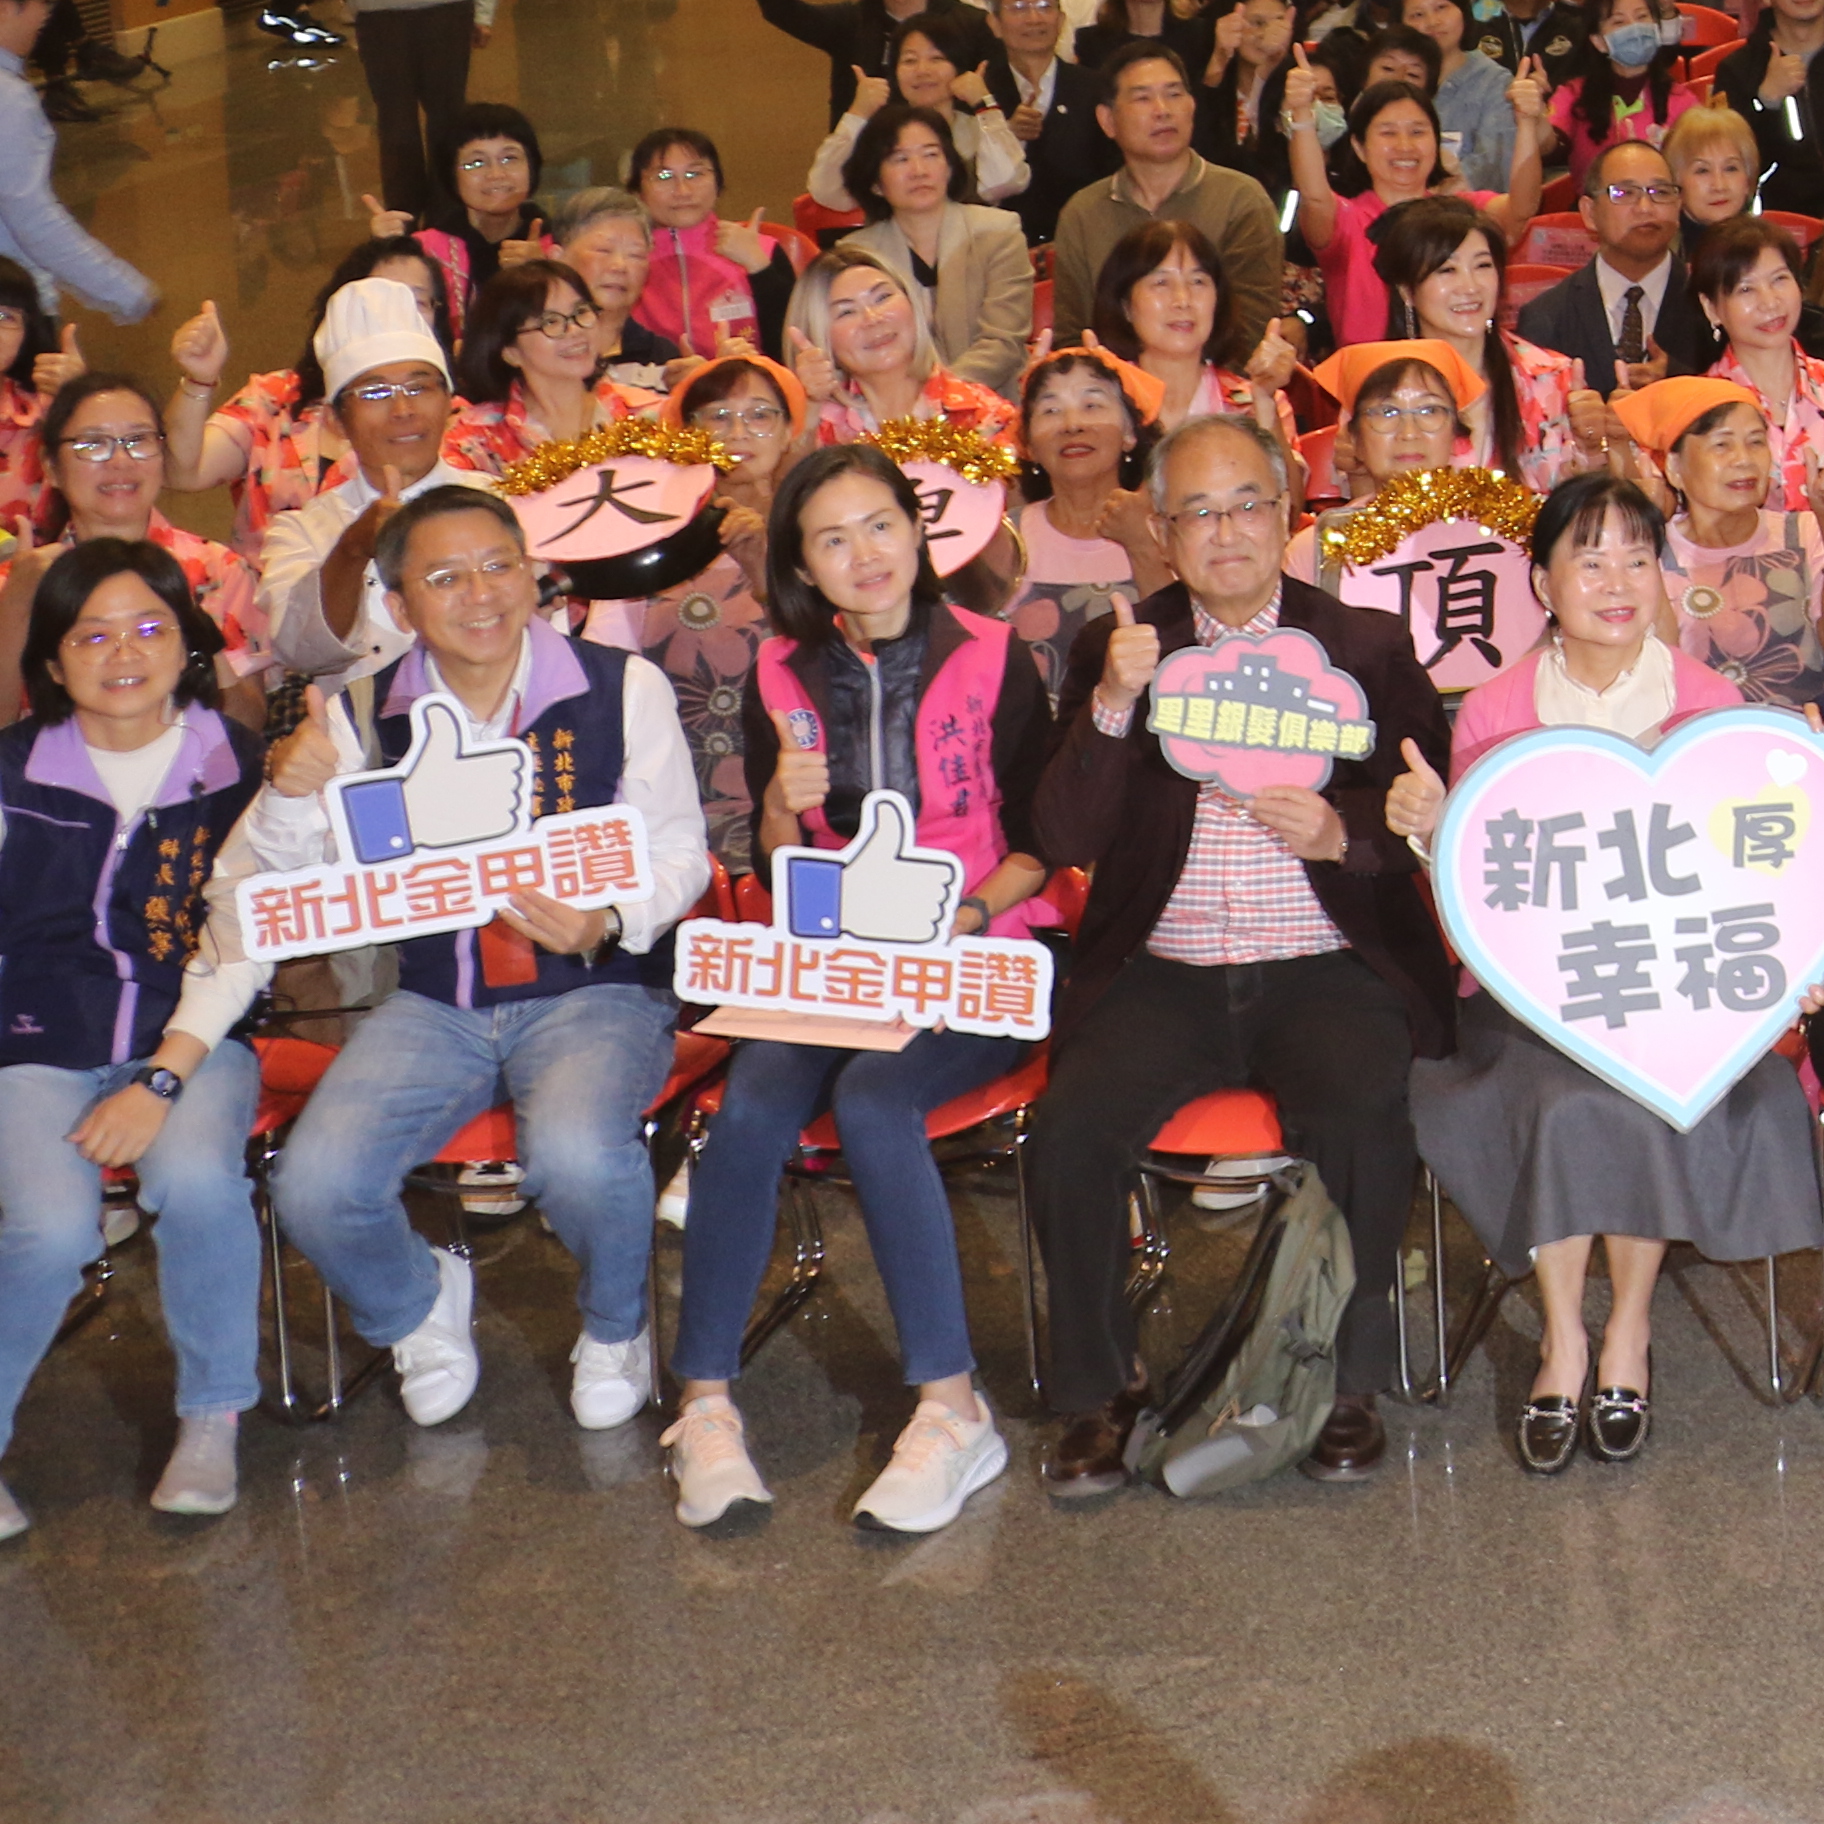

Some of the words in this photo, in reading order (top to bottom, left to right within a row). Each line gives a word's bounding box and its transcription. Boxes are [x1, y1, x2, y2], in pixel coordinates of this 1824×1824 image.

[536, 469, 683, 547] 大
[1371, 541, 1506, 670] 頂
[251, 818, 640, 947] 新北金甲讚
[688, 932, 1040, 1026] 新北金甲讚
[1558, 904, 1788, 1030] 幸福
